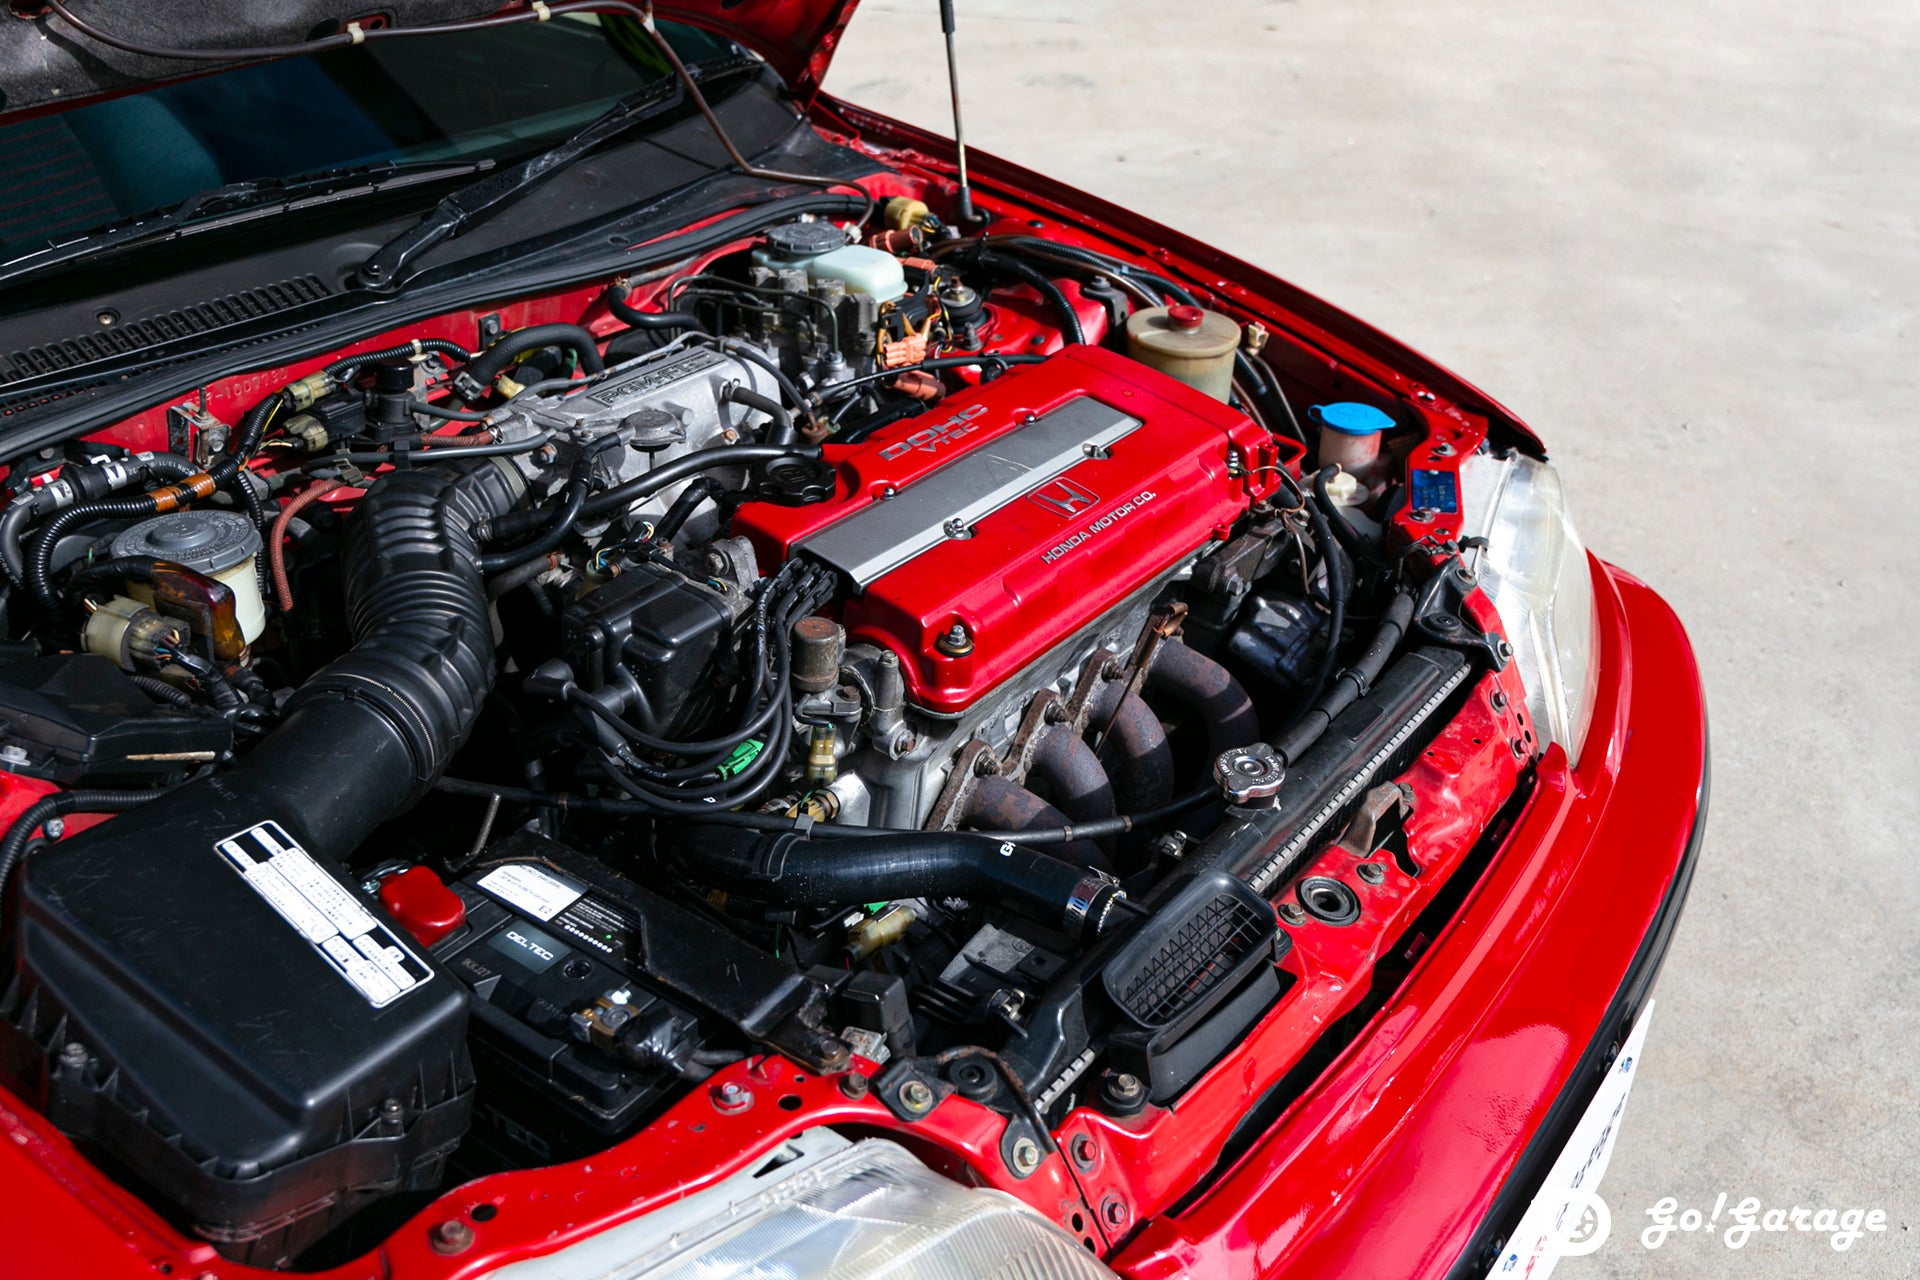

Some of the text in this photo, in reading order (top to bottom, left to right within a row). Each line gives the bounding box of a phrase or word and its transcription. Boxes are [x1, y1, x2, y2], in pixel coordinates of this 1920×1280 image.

[878, 404, 988, 461] DOHC
[918, 422, 980, 452] VTEC
[1040, 490, 1157, 564] HONDA MOTOR CO.
